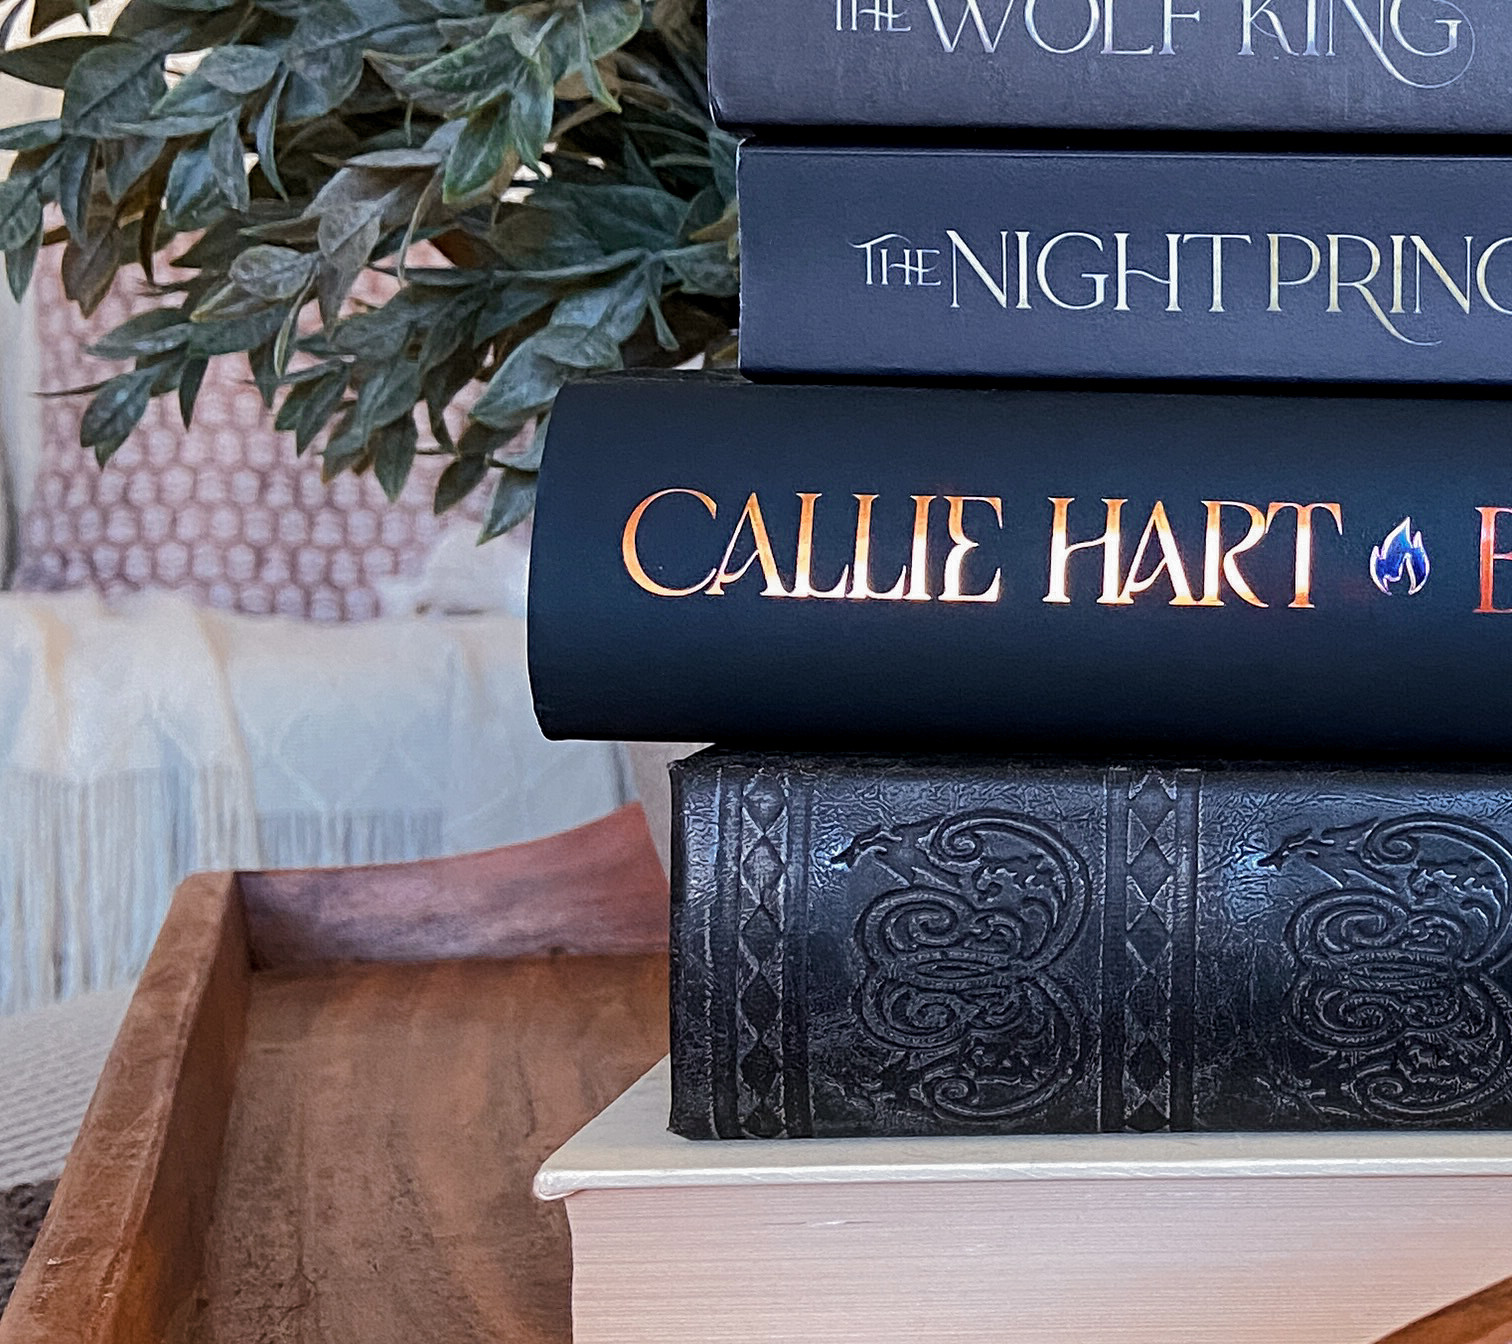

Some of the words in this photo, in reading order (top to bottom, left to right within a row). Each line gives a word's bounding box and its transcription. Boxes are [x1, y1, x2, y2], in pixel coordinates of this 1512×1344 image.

[945, 229, 1252, 313] NIGHT
[620, 487, 1003, 604] CALLIE
[1042, 496, 1344, 609] HART
